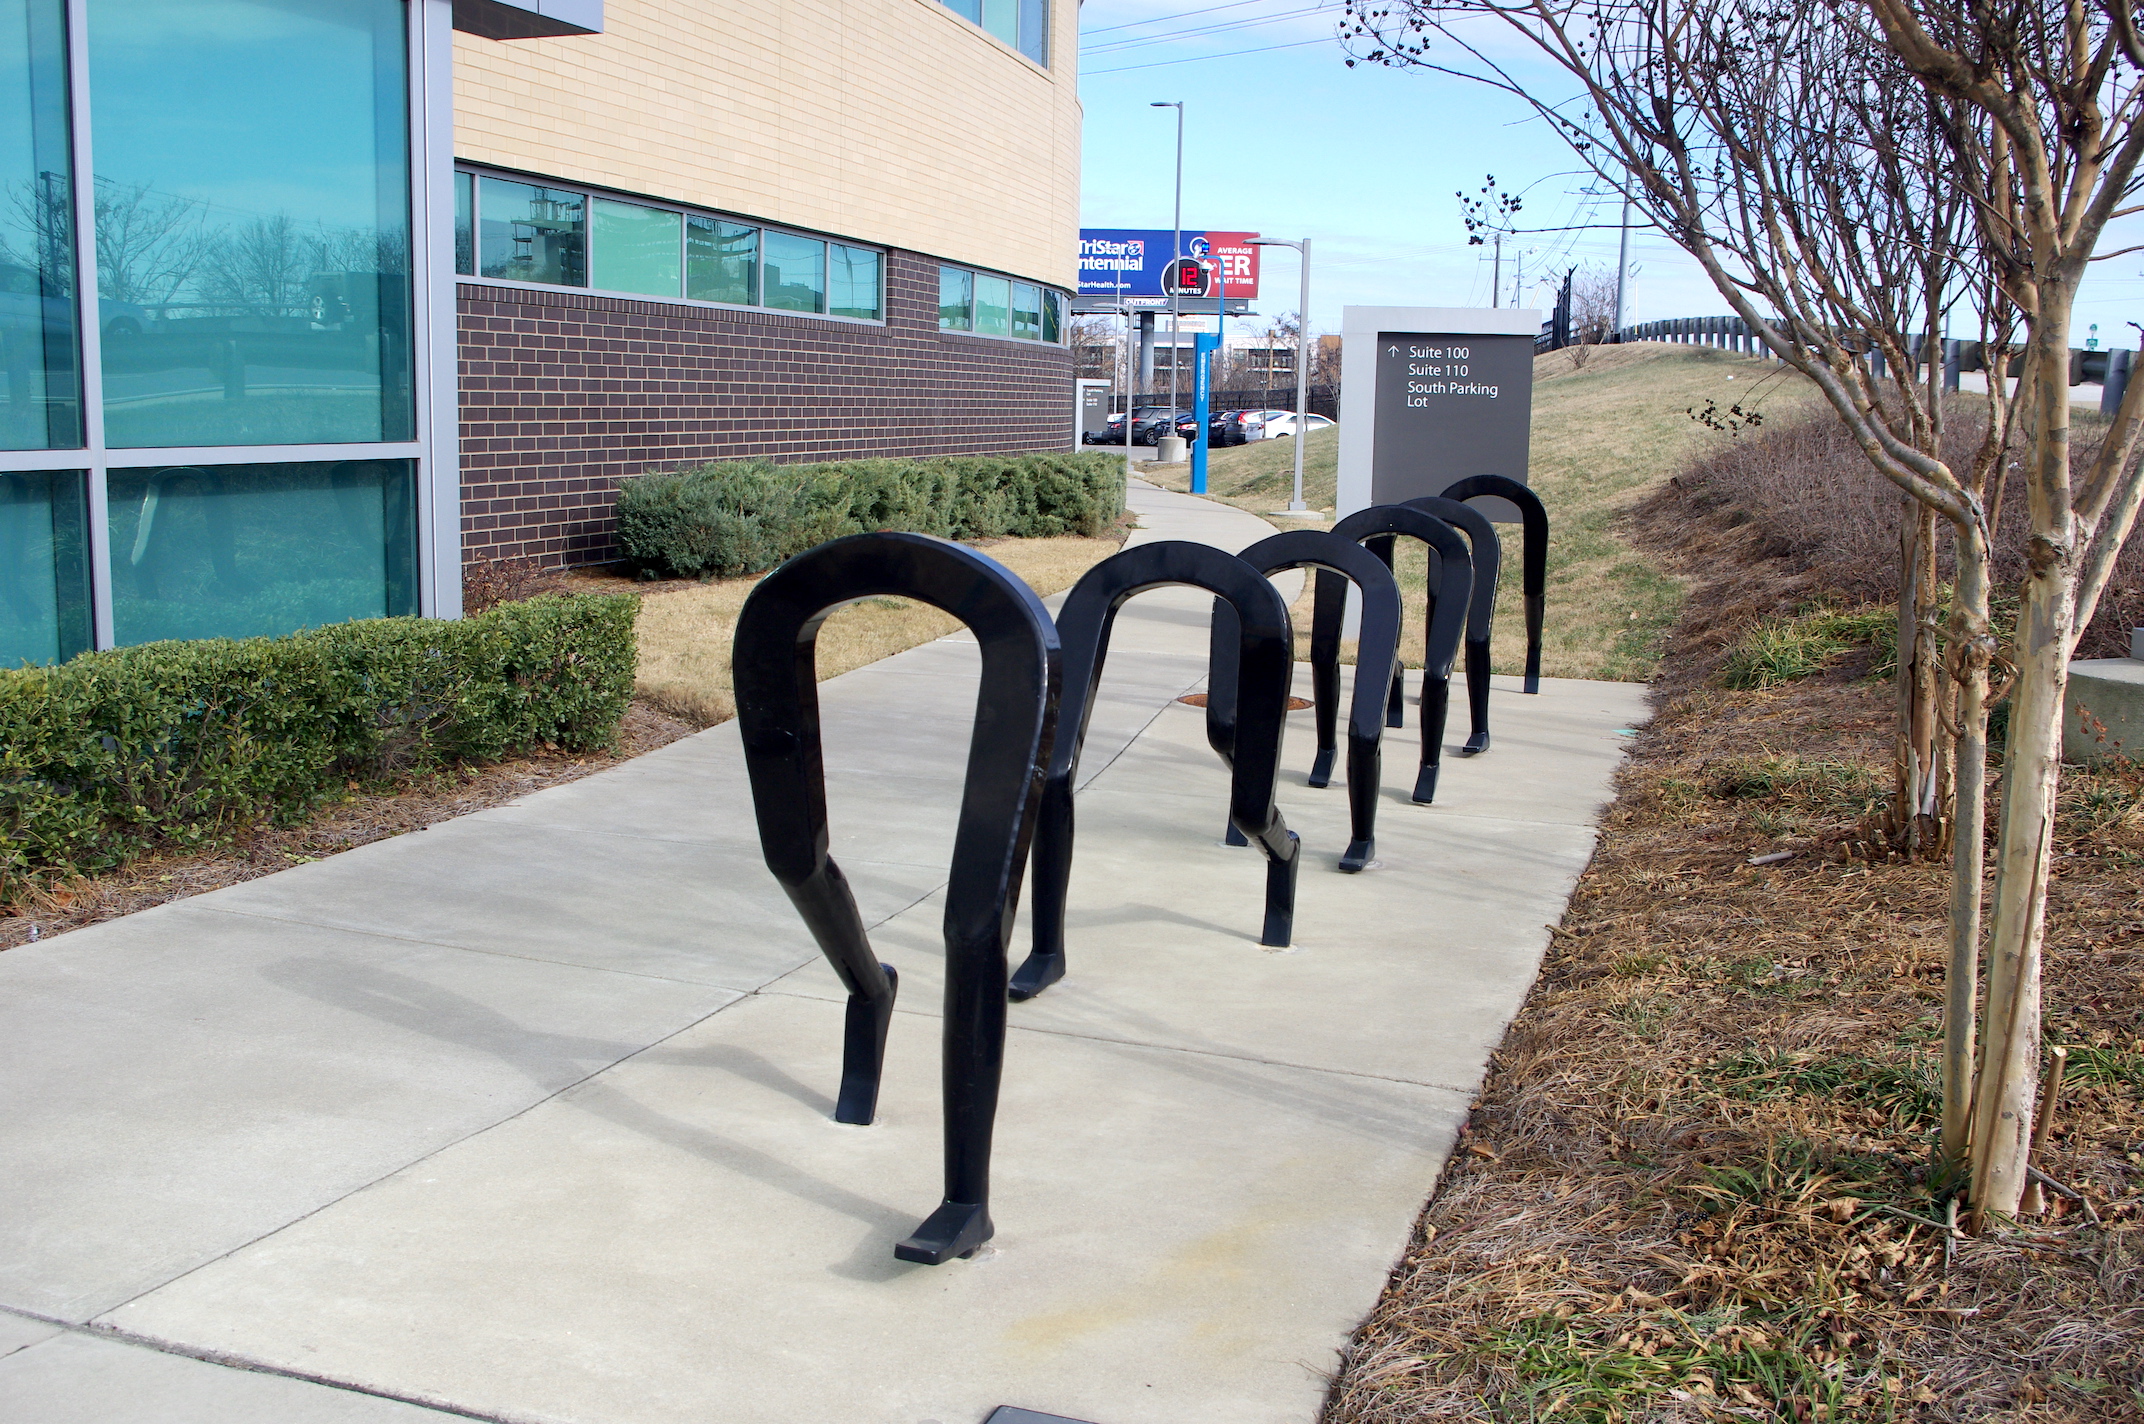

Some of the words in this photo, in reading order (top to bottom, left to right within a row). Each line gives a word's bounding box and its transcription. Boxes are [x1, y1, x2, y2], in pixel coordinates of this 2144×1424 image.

[1079, 239, 1128, 255] TriStar
[1219, 255, 1251, 276] ER
[1182, 267, 1197, 285] 12
[1235, 277, 1254, 285] TIME
[1409, 345, 1442, 359] Suite
[1446, 346, 1470, 360] 100
[1408, 363, 1441, 377] Suite
[1445, 364, 1469, 377] 110
[1407, 380, 1446, 394] South
[1449, 381, 1499, 399] Parking
[1407, 395, 1429, 408] Lot
